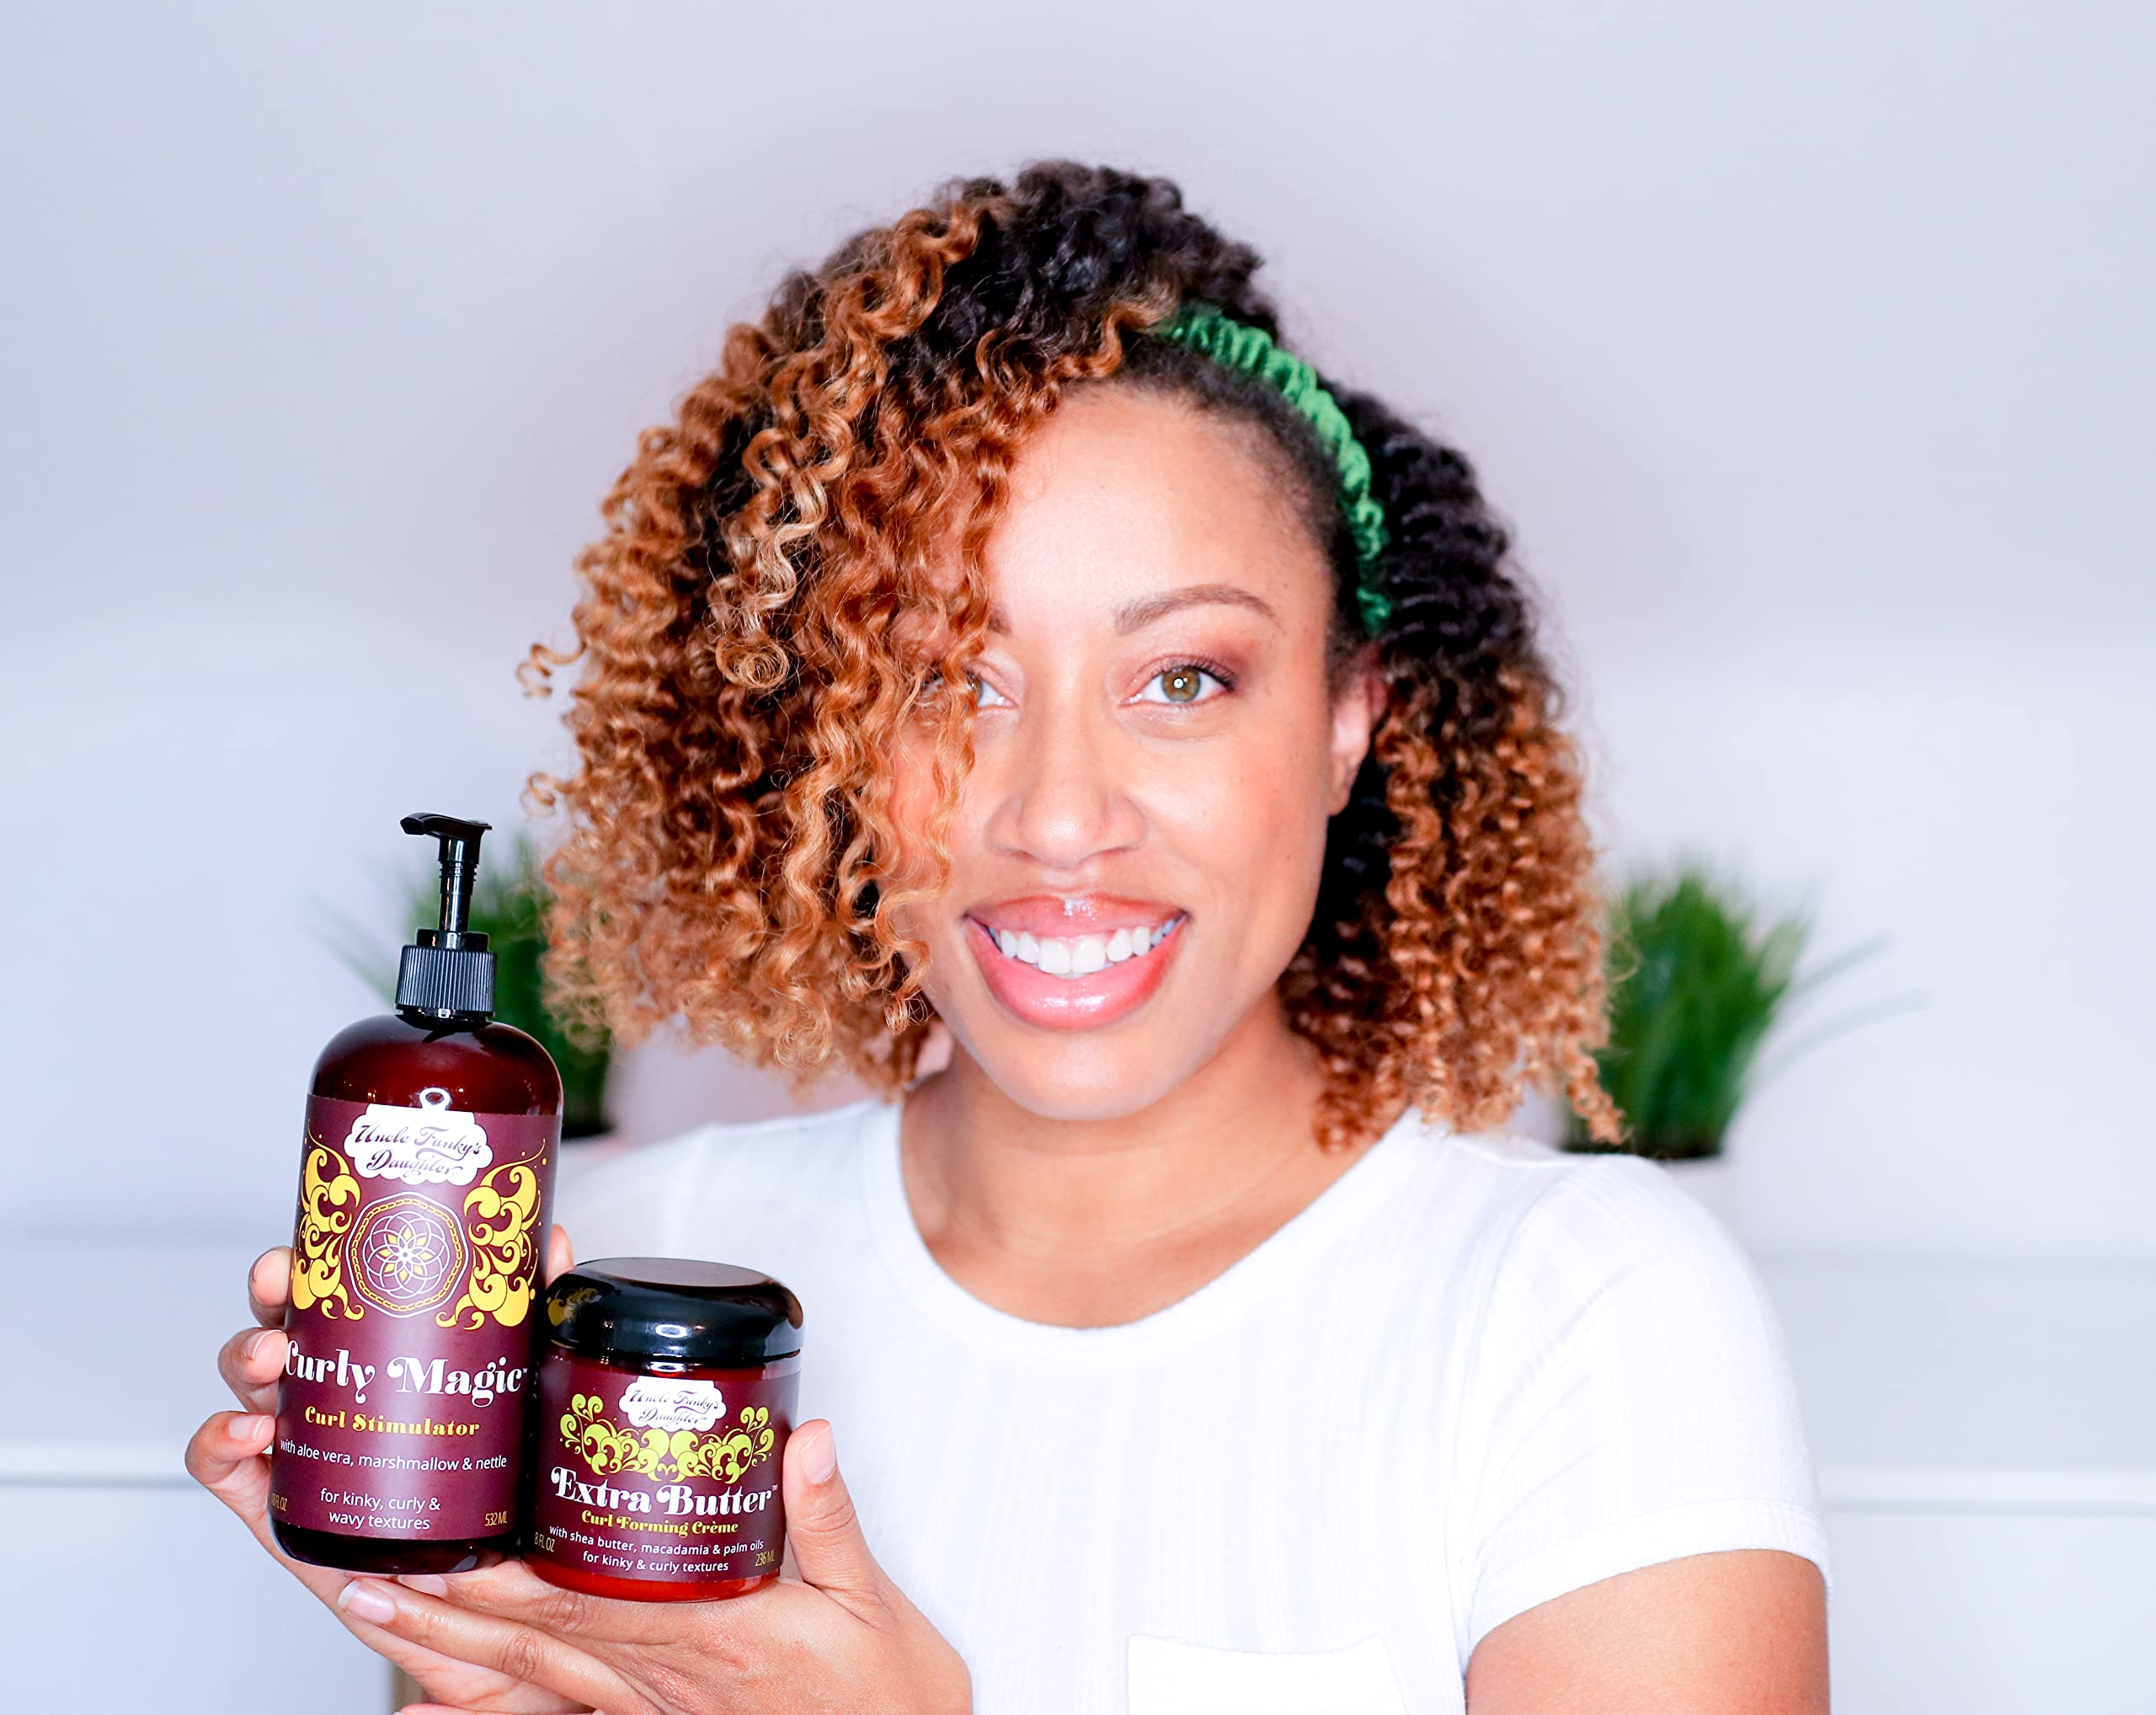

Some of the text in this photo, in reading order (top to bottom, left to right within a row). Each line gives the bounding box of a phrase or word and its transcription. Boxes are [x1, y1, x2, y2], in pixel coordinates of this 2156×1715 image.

[354, 1125, 482, 1162] Uncle Funky's
[366, 1149, 463, 1177] Daughter
[286, 1339, 376, 1404] Curly
[628, 1389, 720, 1413] Uncle Funky's
[305, 1406, 481, 1436] Curl Stimulator
[638, 1407, 708, 1426] Daughter
[280, 1438, 507, 1472] with aloe vera, marshmallow & nettle
[320, 1488, 440, 1513] for kinky, curly &
[550, 1466, 652, 1514] Extra
[328, 1511, 430, 1530] wavy textures
[581, 1509, 739, 1537] Curl Forming Crème
[549, 1525, 764, 1557] with shea butter, macadamia & palm oils
[583, 1551, 728, 1574] for kinky & curly textures
